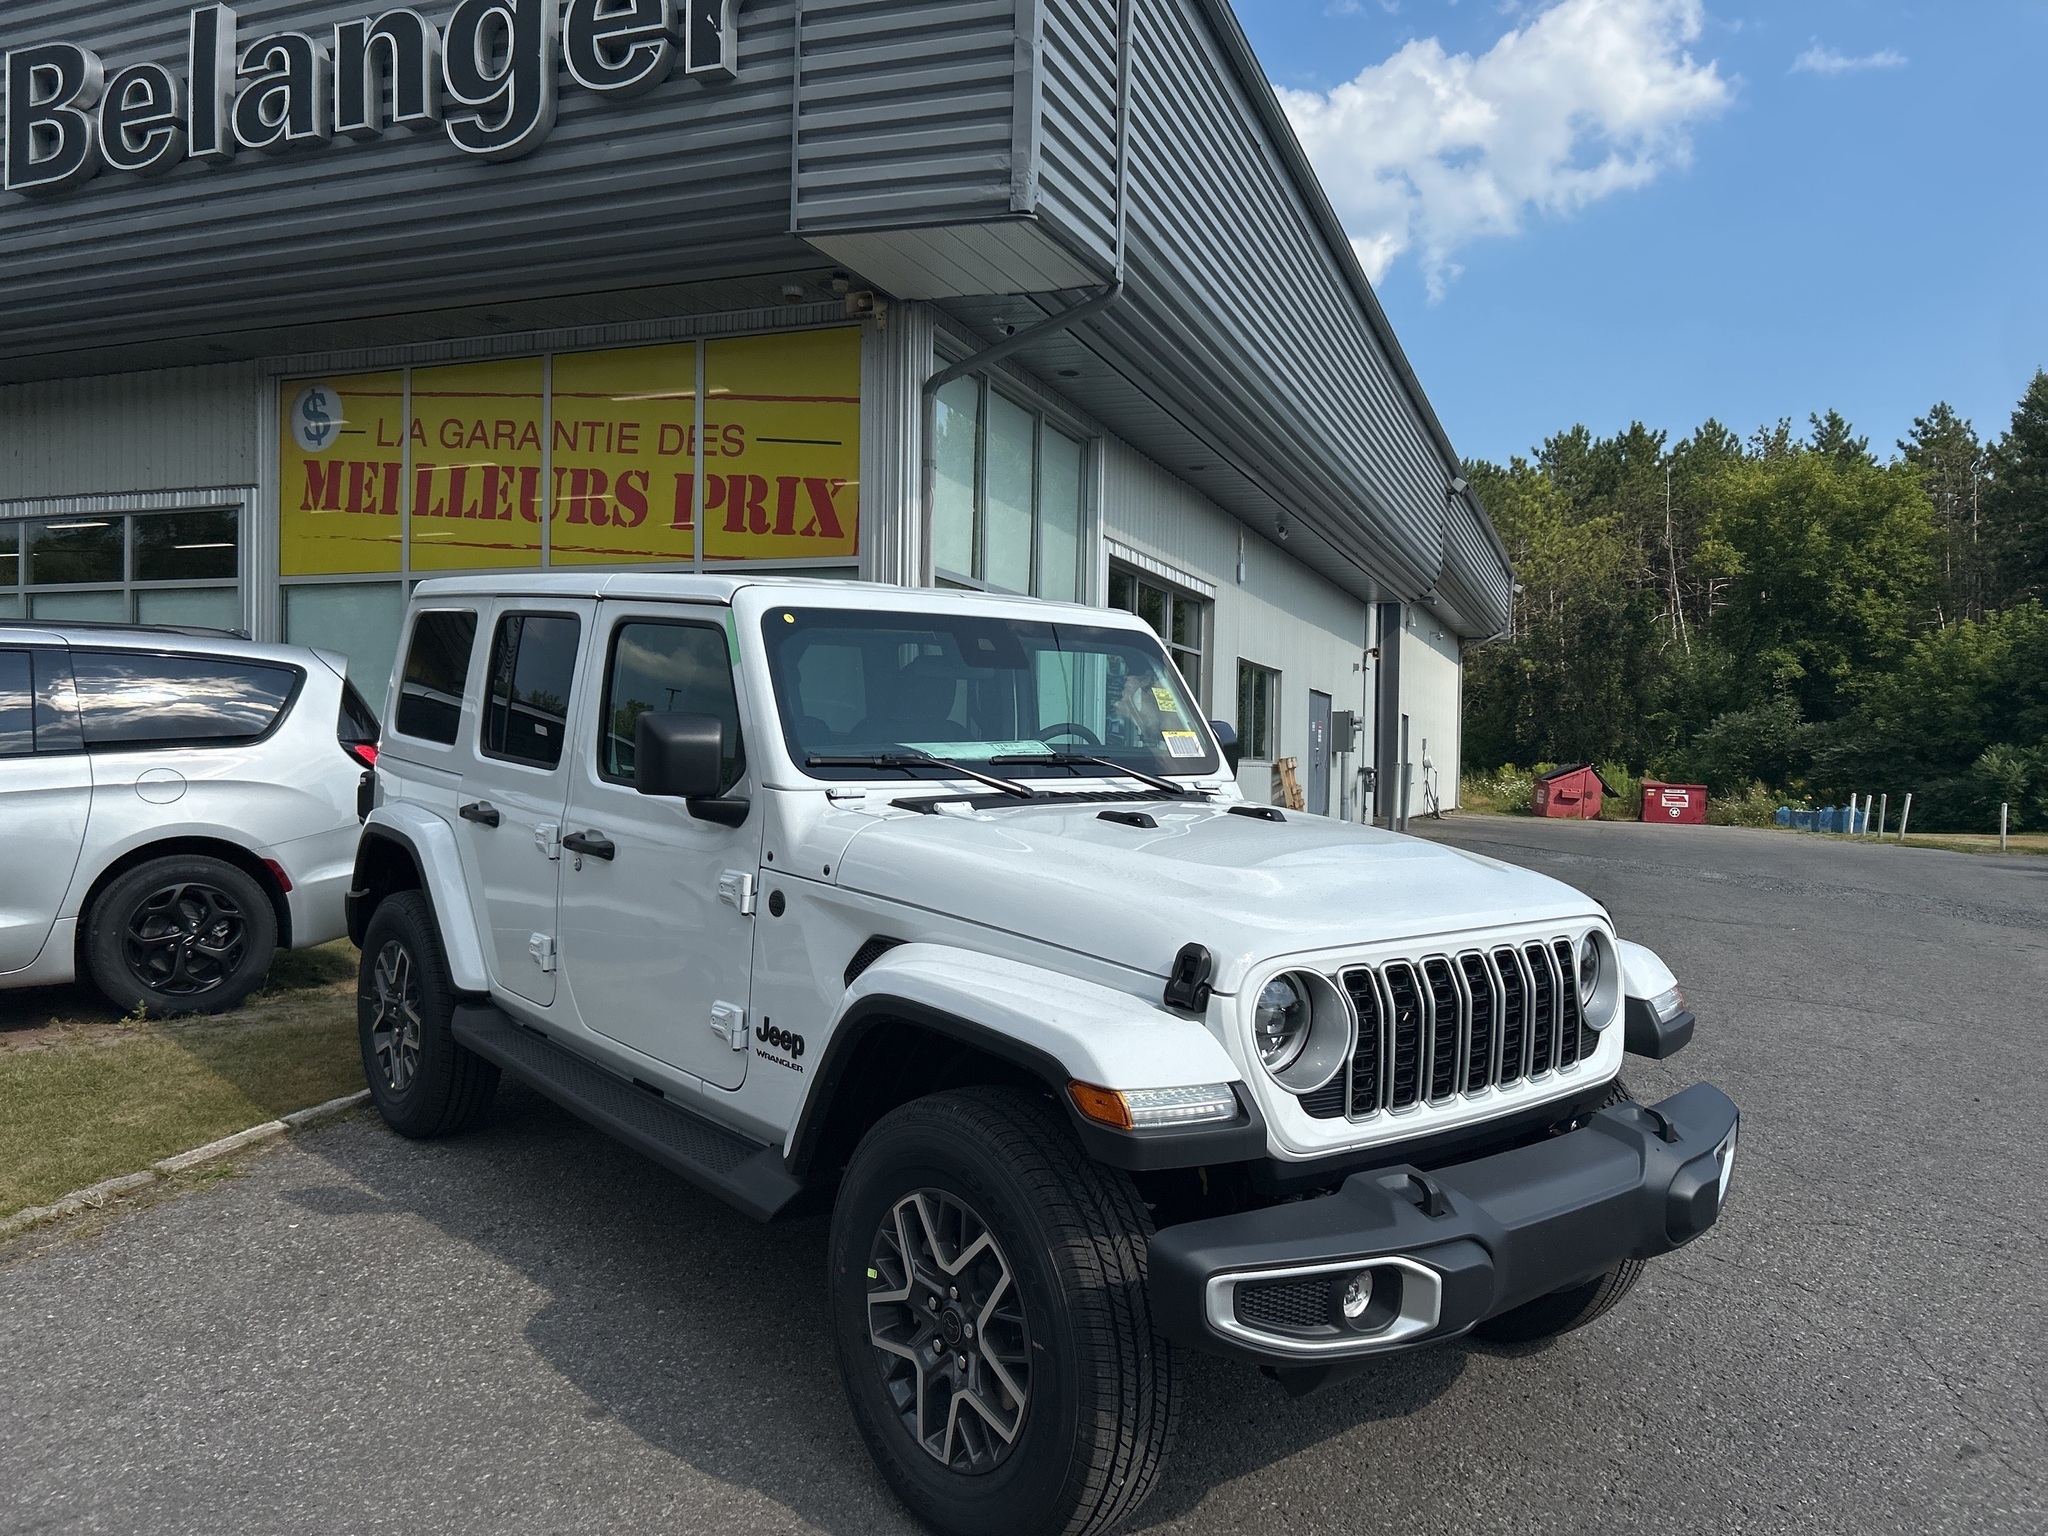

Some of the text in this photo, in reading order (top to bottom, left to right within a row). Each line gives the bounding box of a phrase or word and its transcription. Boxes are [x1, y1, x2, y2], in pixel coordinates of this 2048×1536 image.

[376, 417, 745, 457] LA GARANTIE DES
[300, 459, 848, 539] MEILLEURS PRIX
[756, 1015, 805, 1060] Jeep
[756, 1047, 804, 1074] WRANGLER
